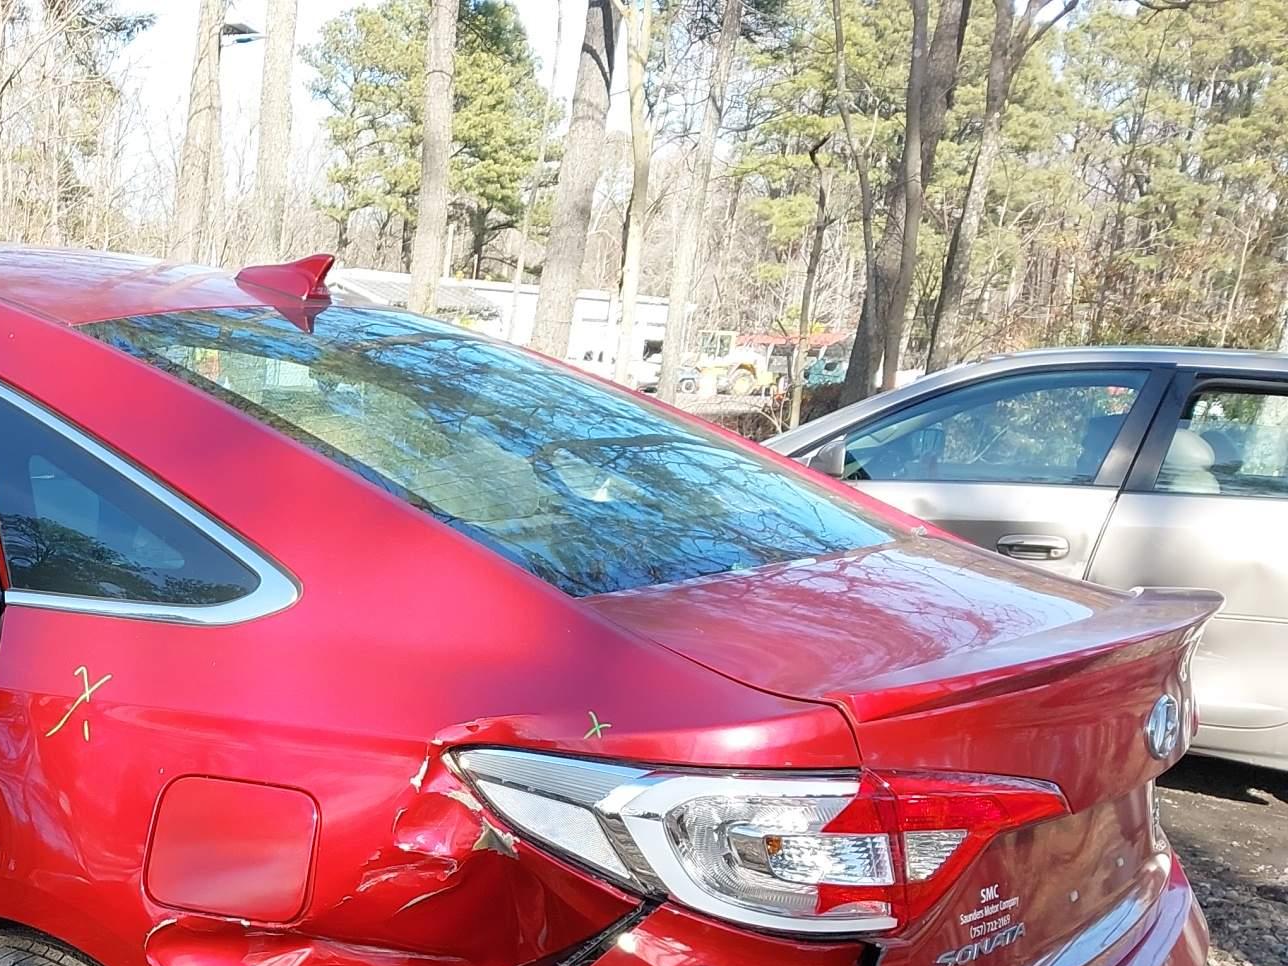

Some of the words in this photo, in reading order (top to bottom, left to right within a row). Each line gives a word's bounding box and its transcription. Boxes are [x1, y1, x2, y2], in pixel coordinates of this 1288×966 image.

[980, 884, 999, 903] SMC
[960, 909, 984, 924] Saunders
[984, 903, 1000, 916] Motor
[1000, 896, 1019, 910] Company
[970, 921, 987, 939] (757)
